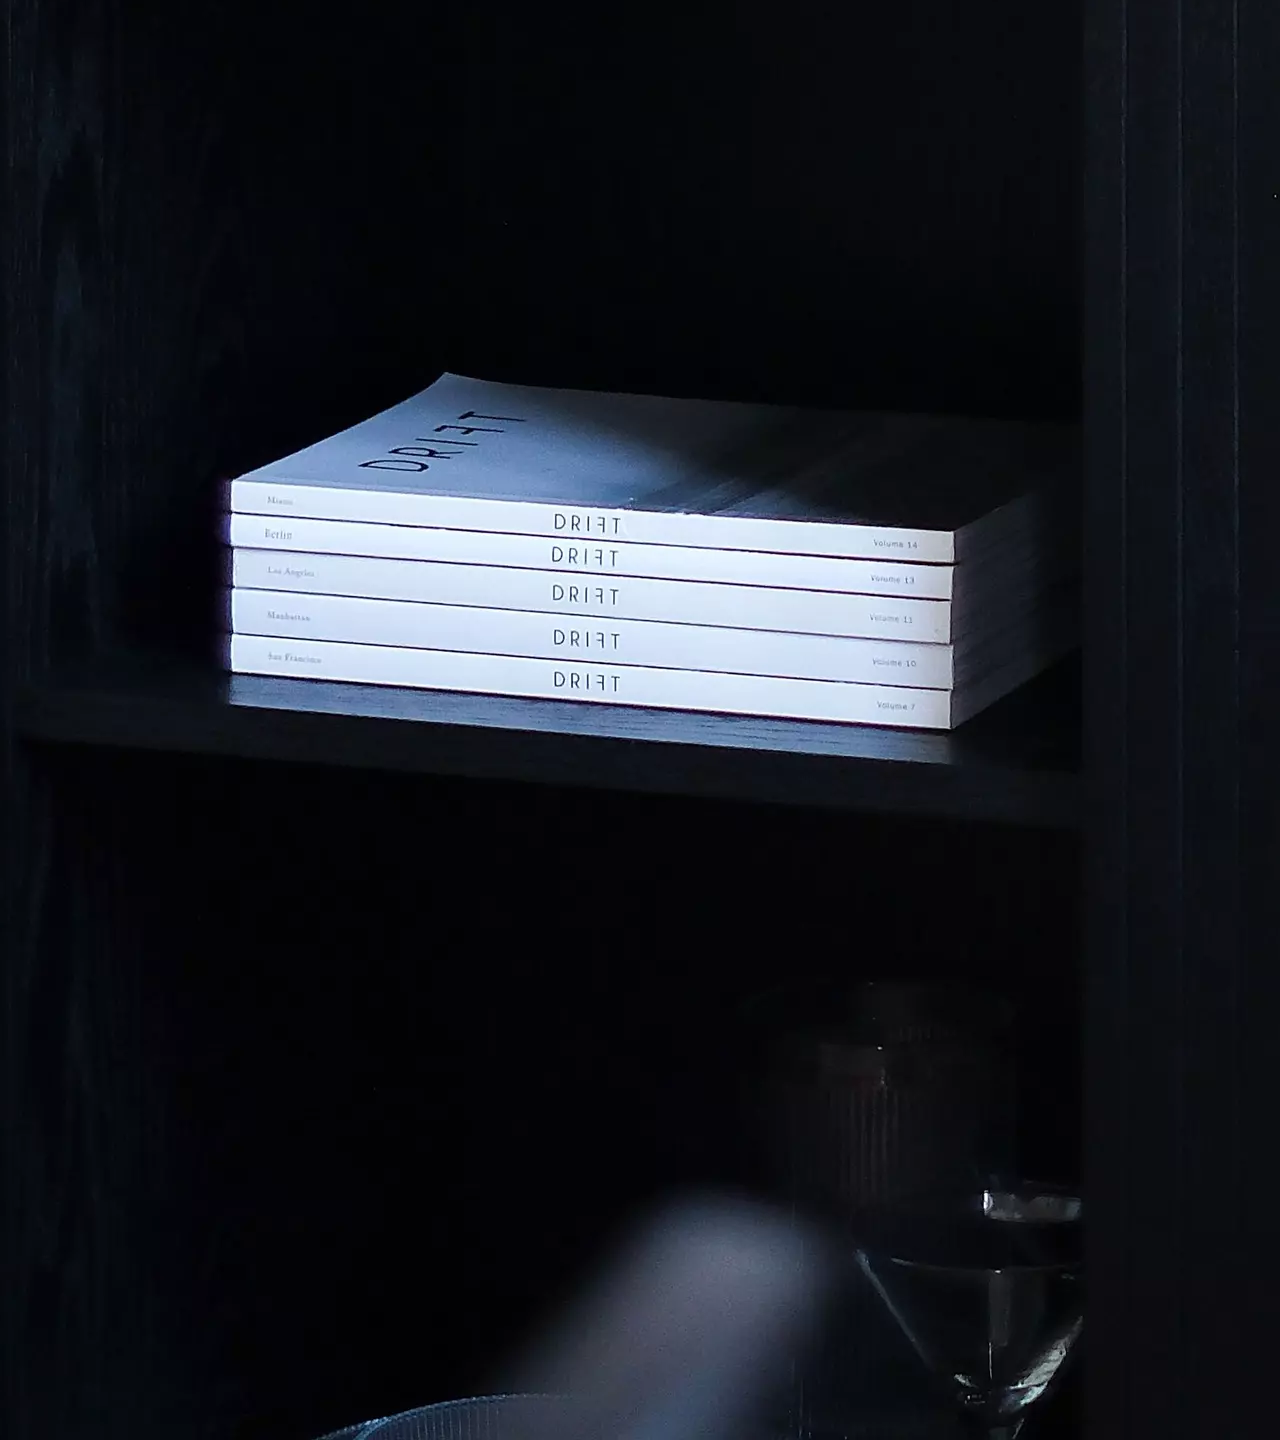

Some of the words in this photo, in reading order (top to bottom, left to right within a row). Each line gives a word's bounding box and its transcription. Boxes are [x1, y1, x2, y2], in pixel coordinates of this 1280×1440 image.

[358, 411, 528, 472] DRIFT
[554, 513, 621, 534] DRIFT
[264, 527, 293, 540] Berlin
[873, 539, 904, 549] Volume
[907, 541, 918, 549] 14
[551, 546, 620, 567] DRIFT
[870, 574, 901, 584] Volume
[904, 576, 915, 584] 13
[552, 584, 620, 605] DRIFT
[266, 610, 311, 622] Manhattan
[553, 629, 621, 650] DRIFT
[872, 657, 903, 667] Volume
[905, 660, 917, 668] 10
[554, 671, 621, 692] DRIFT
[876, 700, 908, 710] Volume
